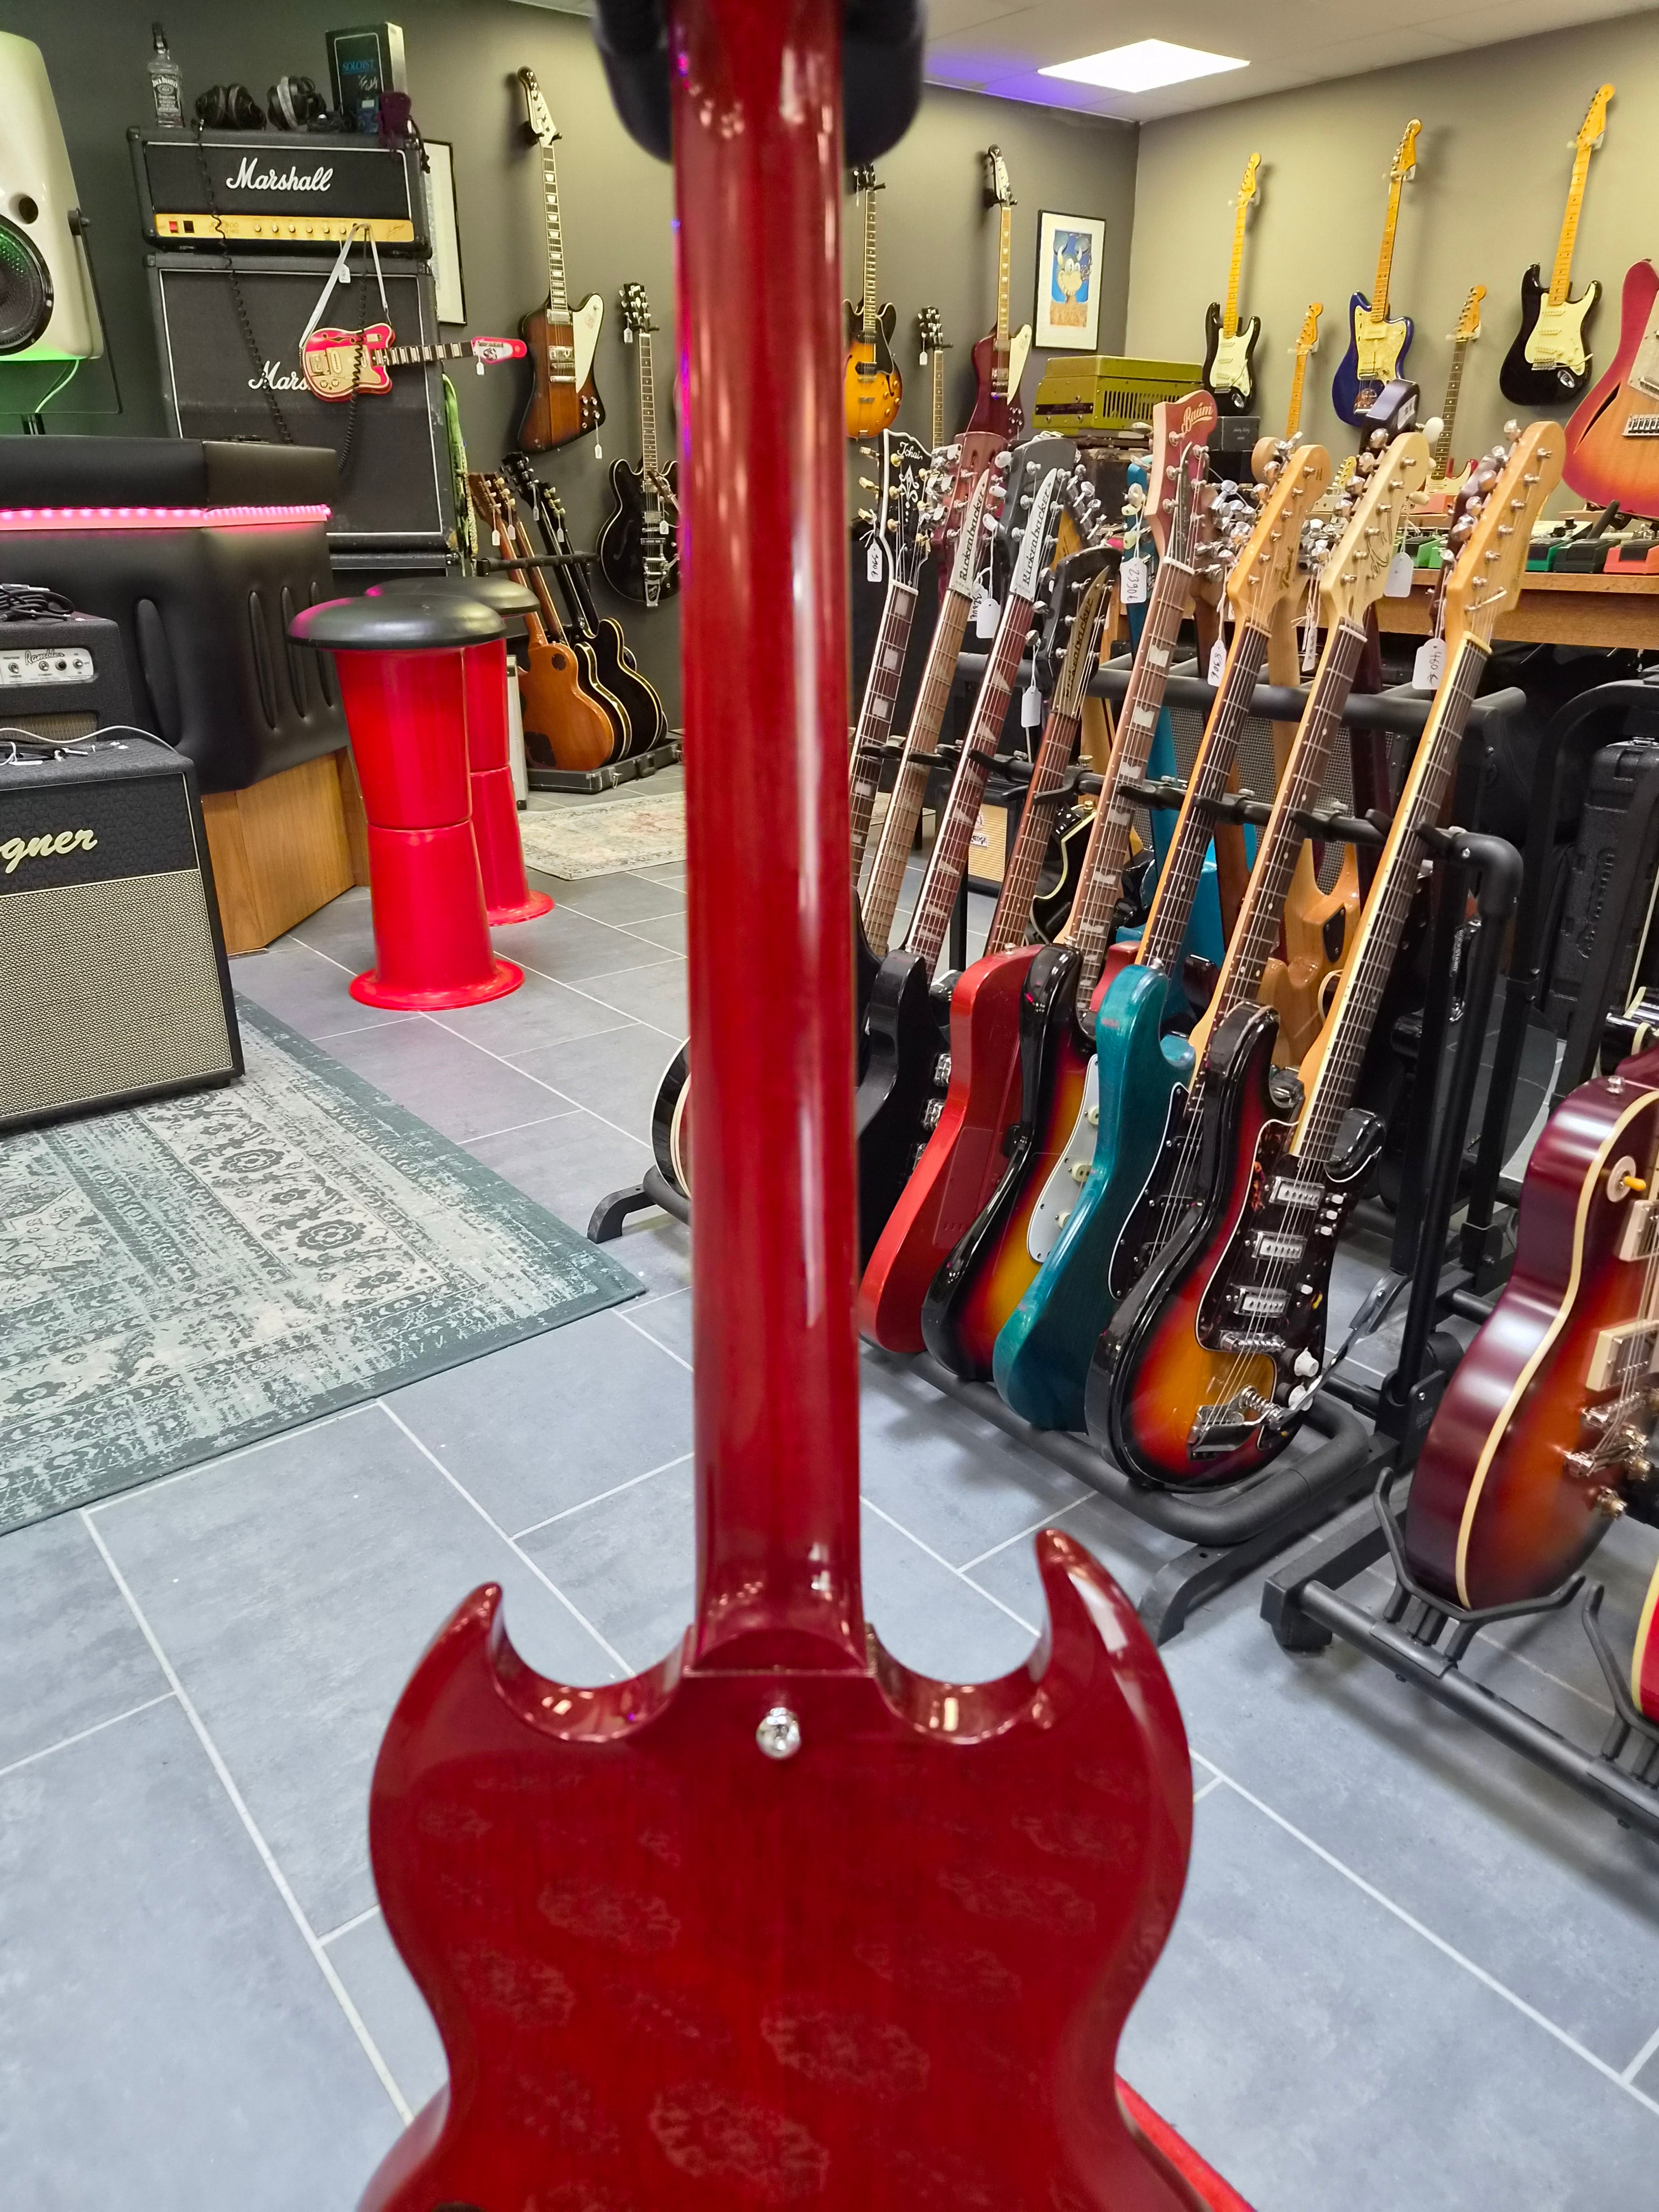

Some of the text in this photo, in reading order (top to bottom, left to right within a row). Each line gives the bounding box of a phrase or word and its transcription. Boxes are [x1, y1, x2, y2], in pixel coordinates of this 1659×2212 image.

[226, 157, 333, 191] Marshall
[248, 361, 311, 390] Mars
[959, 490, 985, 582] Rickenbacker
[1022, 489, 1051, 586] Rickenbacker
[25, 649, 65, 666] Rambler
[0, 830, 98, 874] gner
